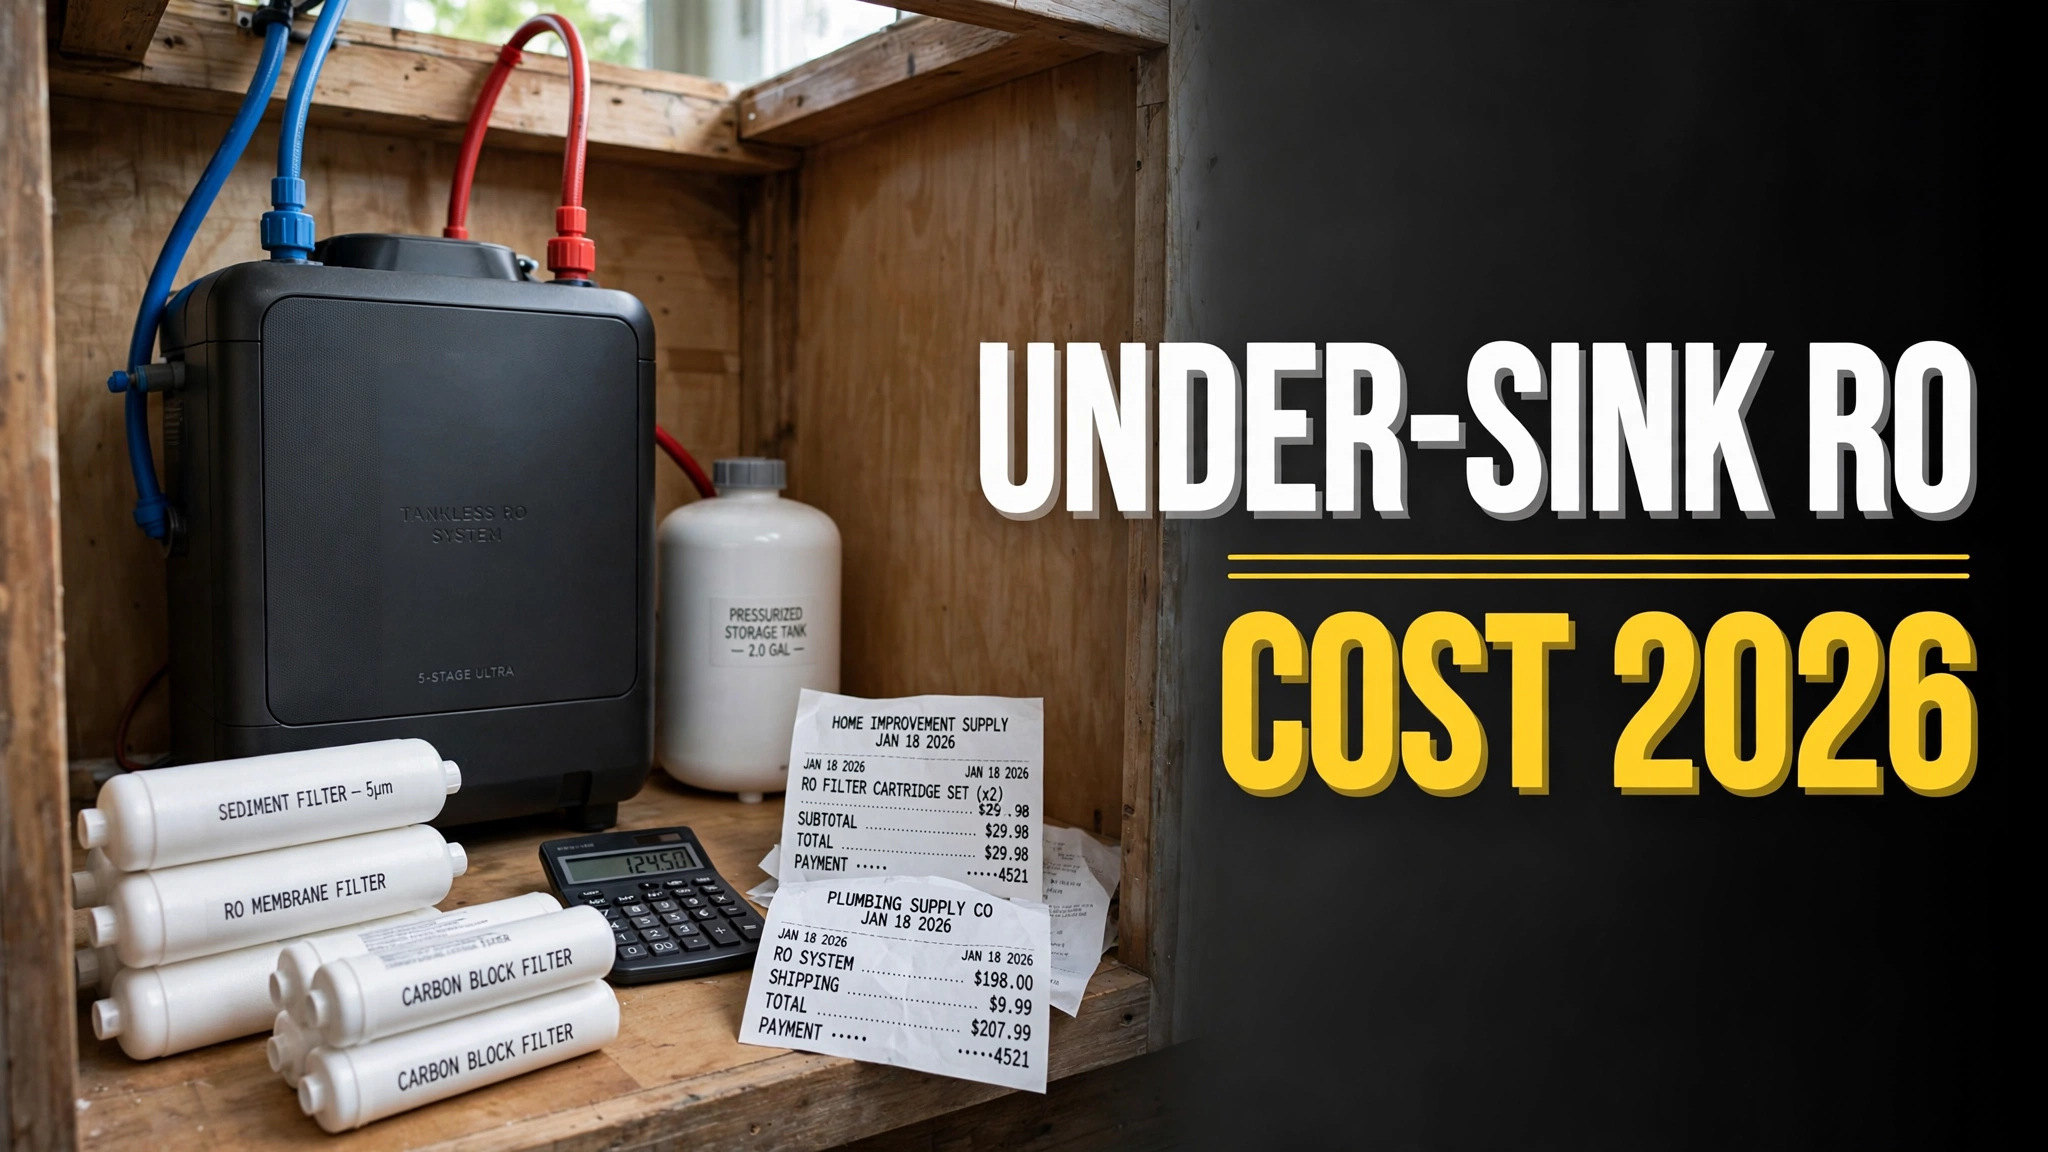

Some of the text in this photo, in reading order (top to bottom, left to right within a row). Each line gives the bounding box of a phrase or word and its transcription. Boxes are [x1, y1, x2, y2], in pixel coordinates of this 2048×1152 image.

[400, 505, 528, 522] TANKLESS RO
[432, 527, 502, 544] SYSTEM
[729, 607, 803, 623] PRESSURIZED
[725, 623, 807, 640] STORAGE TANK
[748, 644, 765, 657] 2.0
[769, 643, 791, 657] GAL
[418, 666, 515, 684] 5-STAGE ULTRA
[832, 715, 1009, 733] HOME IMPROVEMENT SUPPLY
[875, 734, 955, 750] JAN 18 2026
[803, 758, 866, 773] JAN 18 2026
[964, 765, 1029, 780] JAN 18 2026
[801, 777, 1003, 803] RO FILTER CARTRIDGE SET (x2)
[218, 795, 290, 821] SEDIMENT
[297, 785, 347, 809] FILTER
[798, 811, 1029, 839] SUBTOTAL $29.98
[797, 832, 833, 849] TOTAL
[985, 844, 1029, 861] $29.98
[626, 851, 688, 875] 124.50
[794, 854, 848, 872] PAYMENT
[224, 873, 386, 920] RO MEMBRANE FILTER
[827, 891, 993, 918] PLUMBING SUPPLY CO
[861, 911, 952, 933] JAN 18 2026
[778, 928, 848, 948] JAN 18 2026
[774, 946, 1034, 991] RO SYSTEM $198.00
[961, 950, 1034, 966] JAN 18 2026
[402, 977, 462, 1007] CARBON
[470, 962, 516, 990] BLOCK
[523, 948, 573, 976] FILTER
[769, 969, 1032, 1016] SHIPPING $9.99
[765, 992, 1031, 1041] TOTAL $207.99
[759, 1017, 823, 1041] PAYMENT
[398, 1023, 574, 1091] CARBON BLOCK FILTER
